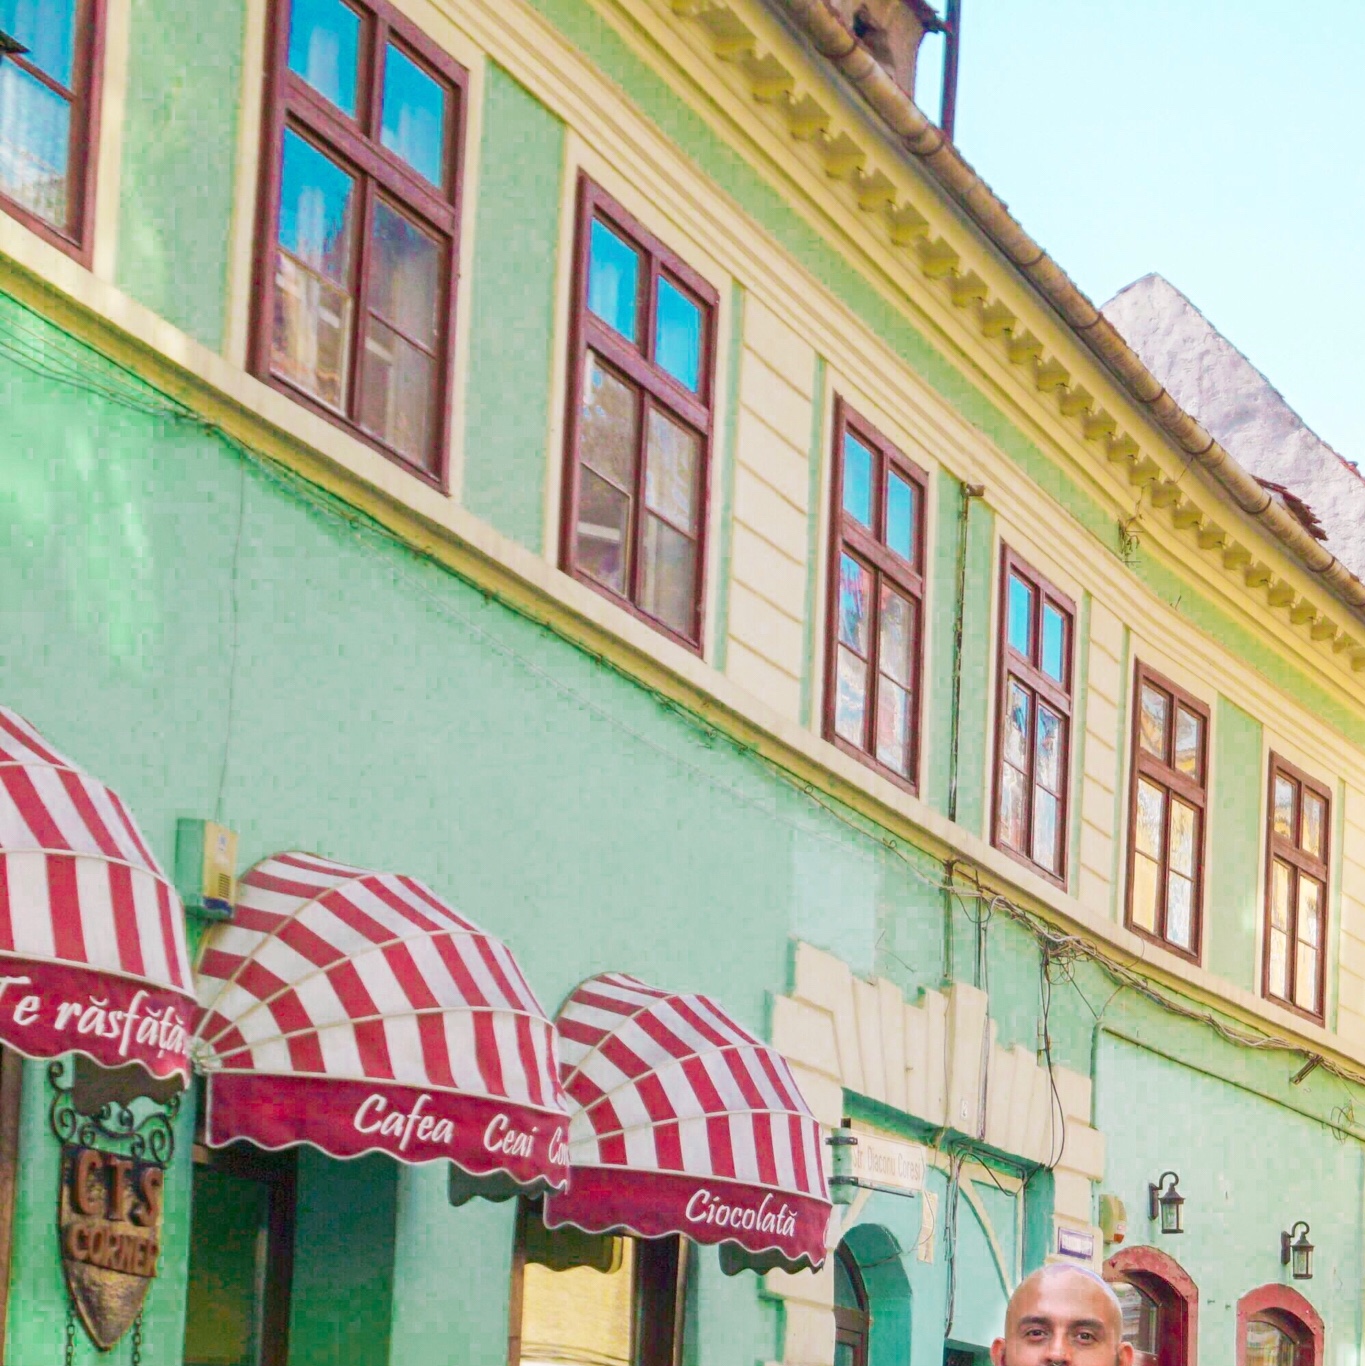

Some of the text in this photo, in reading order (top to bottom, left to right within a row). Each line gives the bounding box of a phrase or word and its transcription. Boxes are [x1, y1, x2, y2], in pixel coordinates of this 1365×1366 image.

[353, 1093, 454, 1151] Cafea
[484, 1113, 538, 1158] Ceai
[76, 1148, 164, 1227] CTS
[685, 1189, 798, 1237] Ciocolată
[65, 1222, 159, 1278] CORNER
